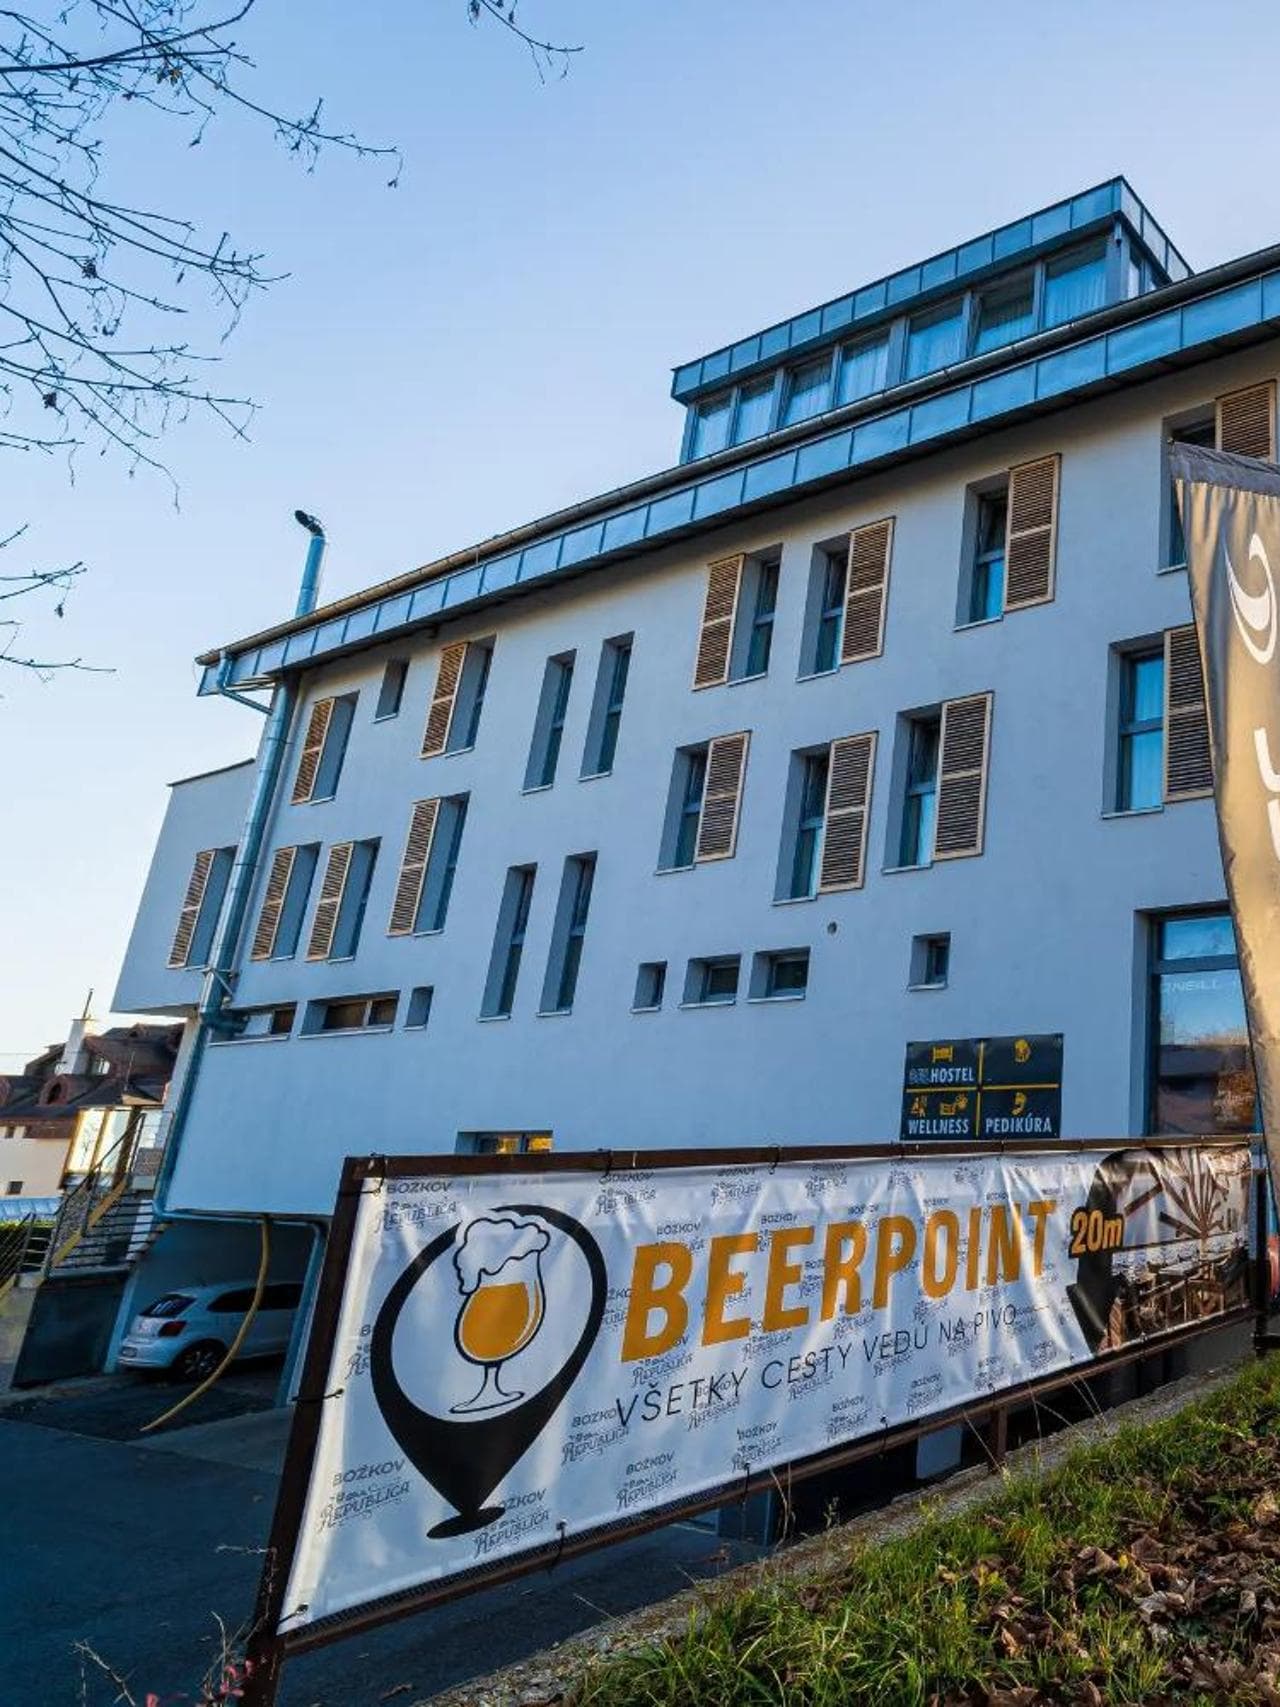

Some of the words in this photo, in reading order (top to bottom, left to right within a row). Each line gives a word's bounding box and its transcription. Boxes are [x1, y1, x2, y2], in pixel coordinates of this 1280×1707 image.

[930, 1067, 975, 1084] HOSTEL
[908, 1118, 969, 1135] WELLNESS
[985, 1112, 1052, 1133] PEDIKÚRA
[620, 1200, 1057, 1362] BEERPOINT
[1070, 1208, 1124, 1255] 20m
[616, 1367, 748, 1427] VŠETKY
[761, 1343, 852, 1389] CESTY
[939, 1317, 966, 1344] NA
[973, 1303, 1016, 1335] PIVO
